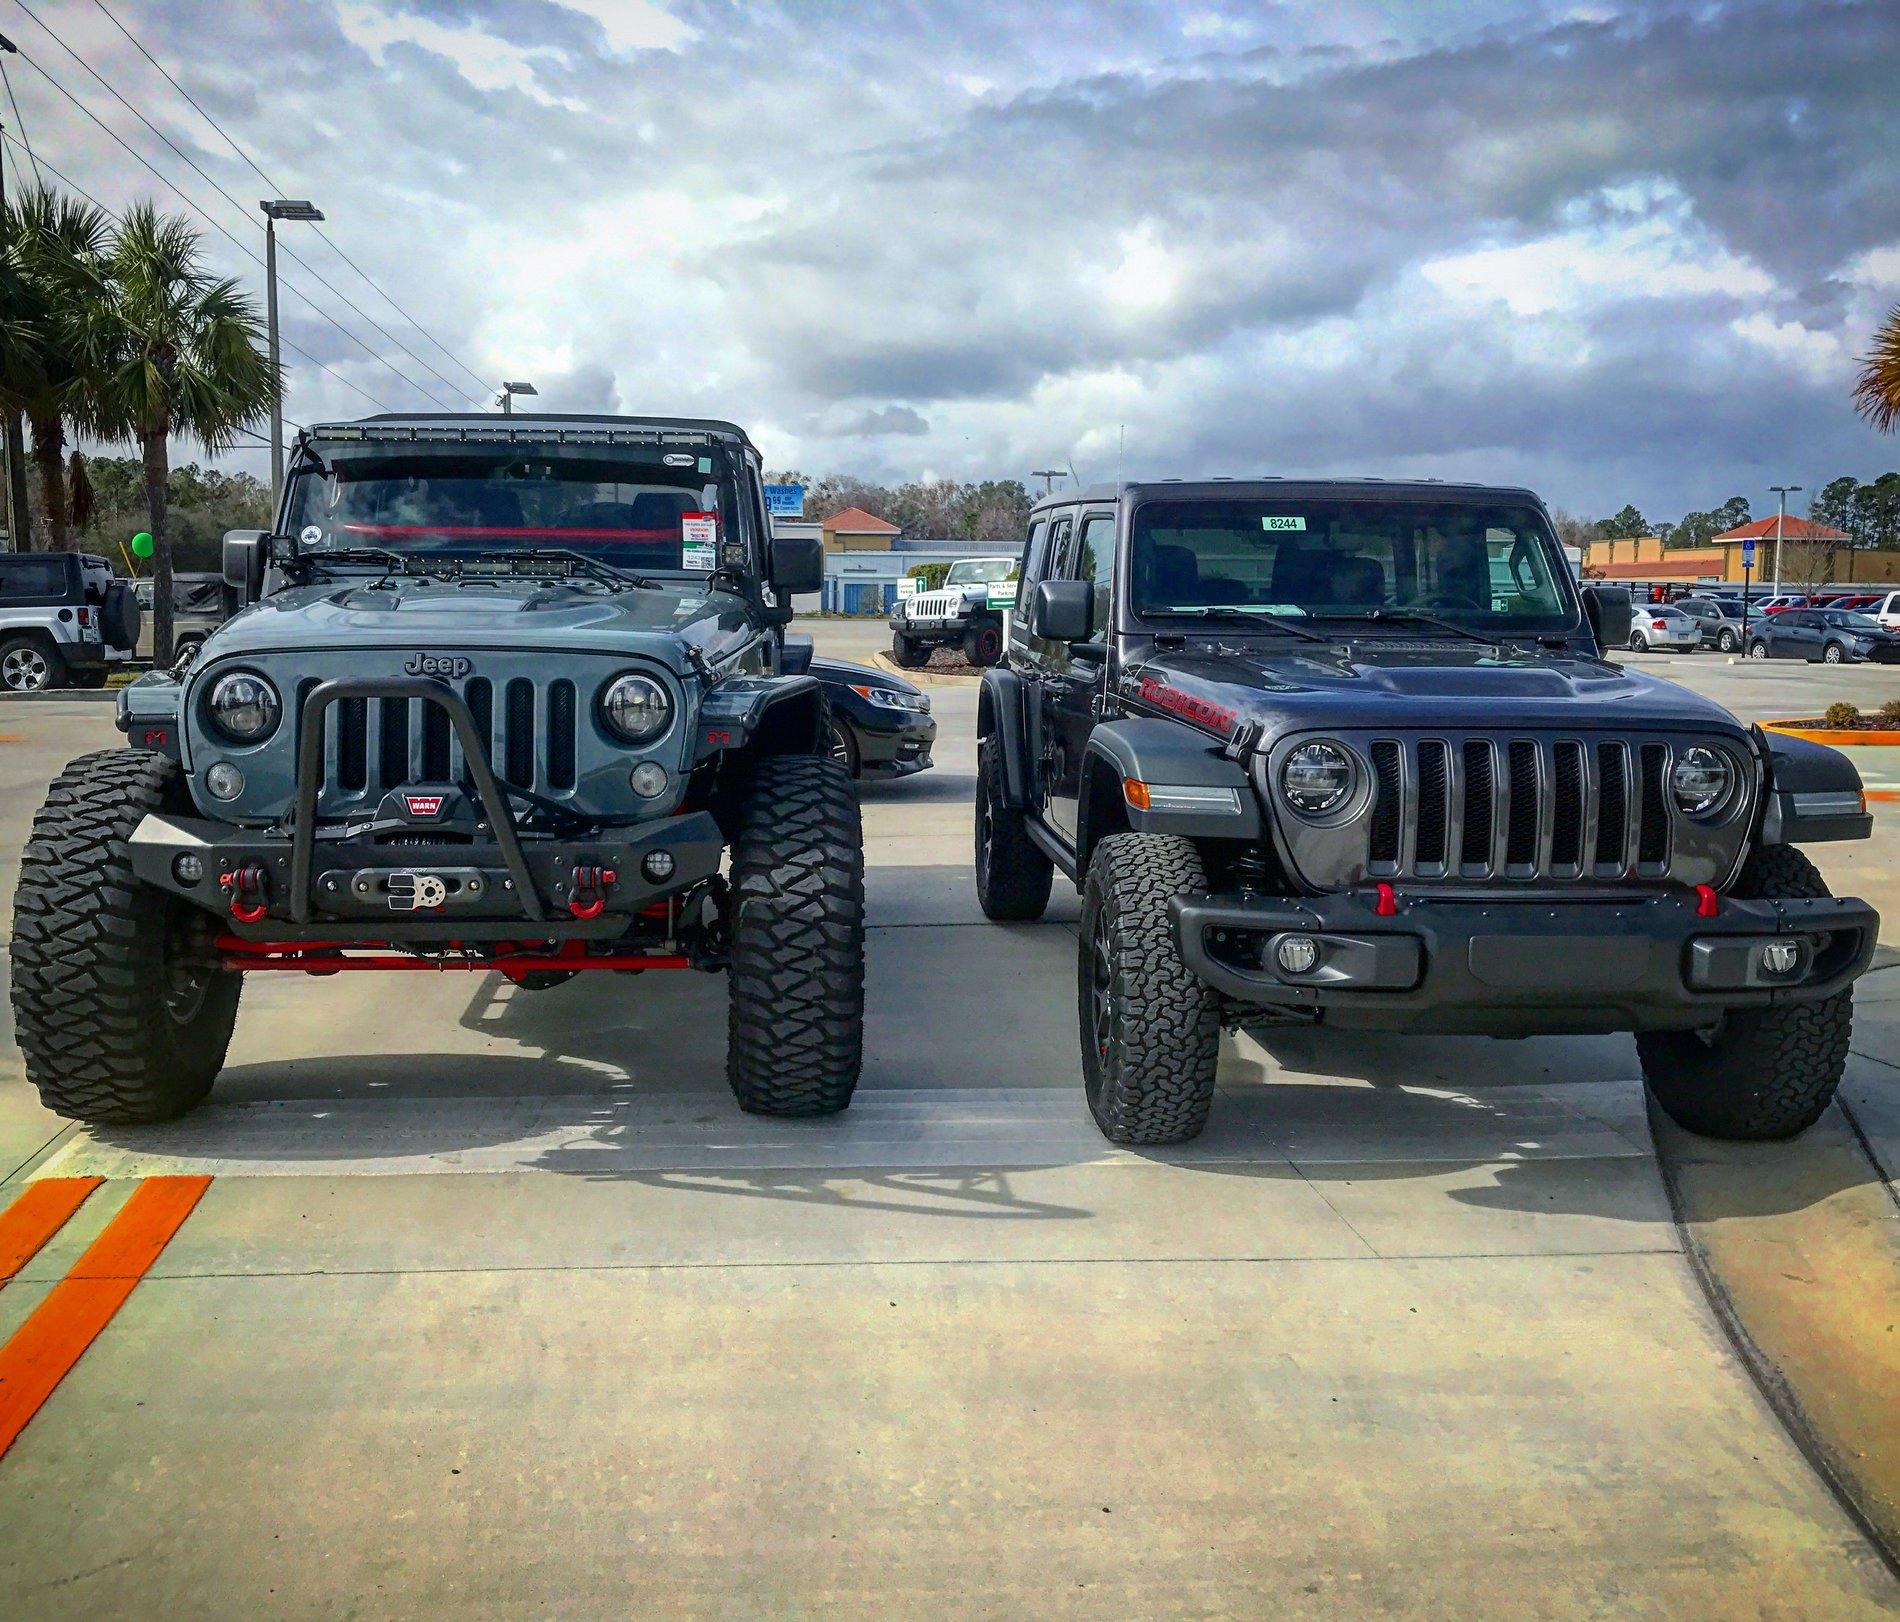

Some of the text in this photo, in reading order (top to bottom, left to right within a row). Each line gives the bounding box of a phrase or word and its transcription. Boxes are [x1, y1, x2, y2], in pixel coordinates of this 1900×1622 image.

[1270, 518, 1297, 529] 8244
[404, 652, 472, 679] Jeep
[1137, 676, 1237, 733] RUBICON
[412, 802, 436, 810] WARN
